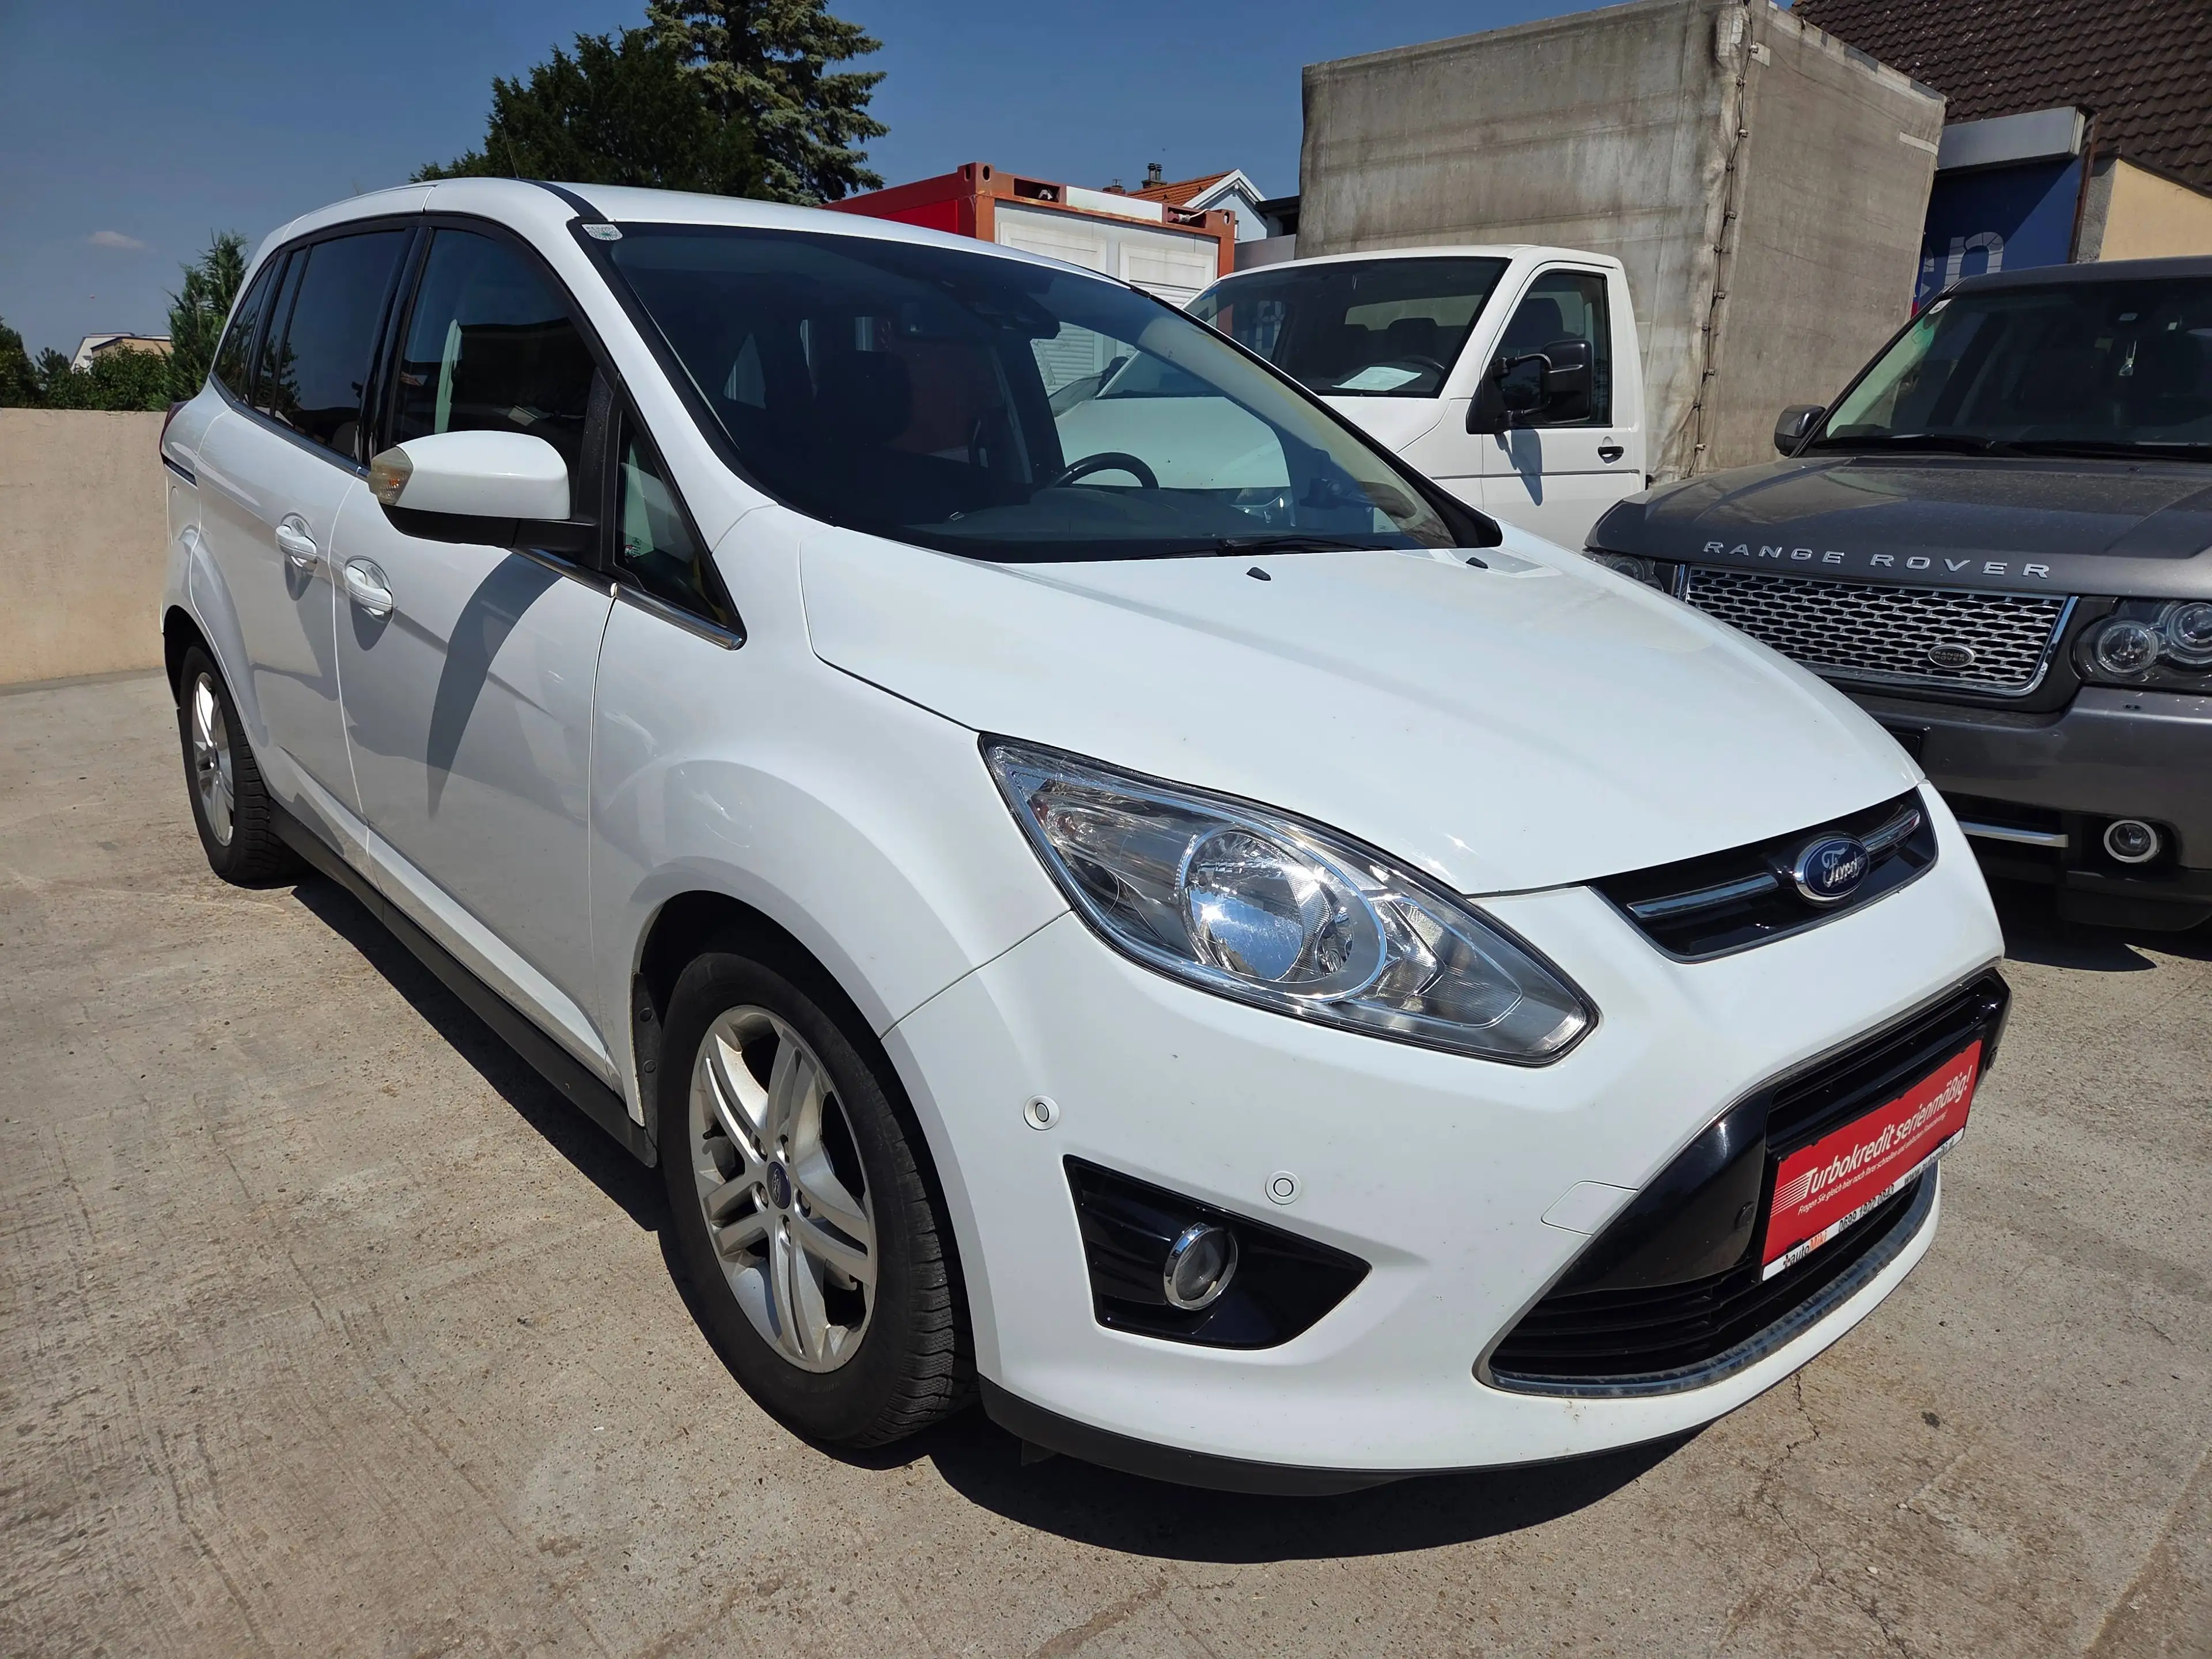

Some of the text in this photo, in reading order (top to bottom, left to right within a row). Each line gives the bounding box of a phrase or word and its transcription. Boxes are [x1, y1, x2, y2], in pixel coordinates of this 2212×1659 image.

[1703, 541, 2050, 579] RANGE ROVER
[1821, 844, 1863, 888] Ford
[1805, 1065, 1973, 1198] Turbokredit serienmäßig!
[1798, 1199, 1817, 1215] Fragen
[1817, 1193, 1826, 1205] Sie
[1825, 1183, 1842, 1202] gleich
[1842, 1179, 1853, 1190] hier
[1839, 1210, 1857, 1233] 0699
